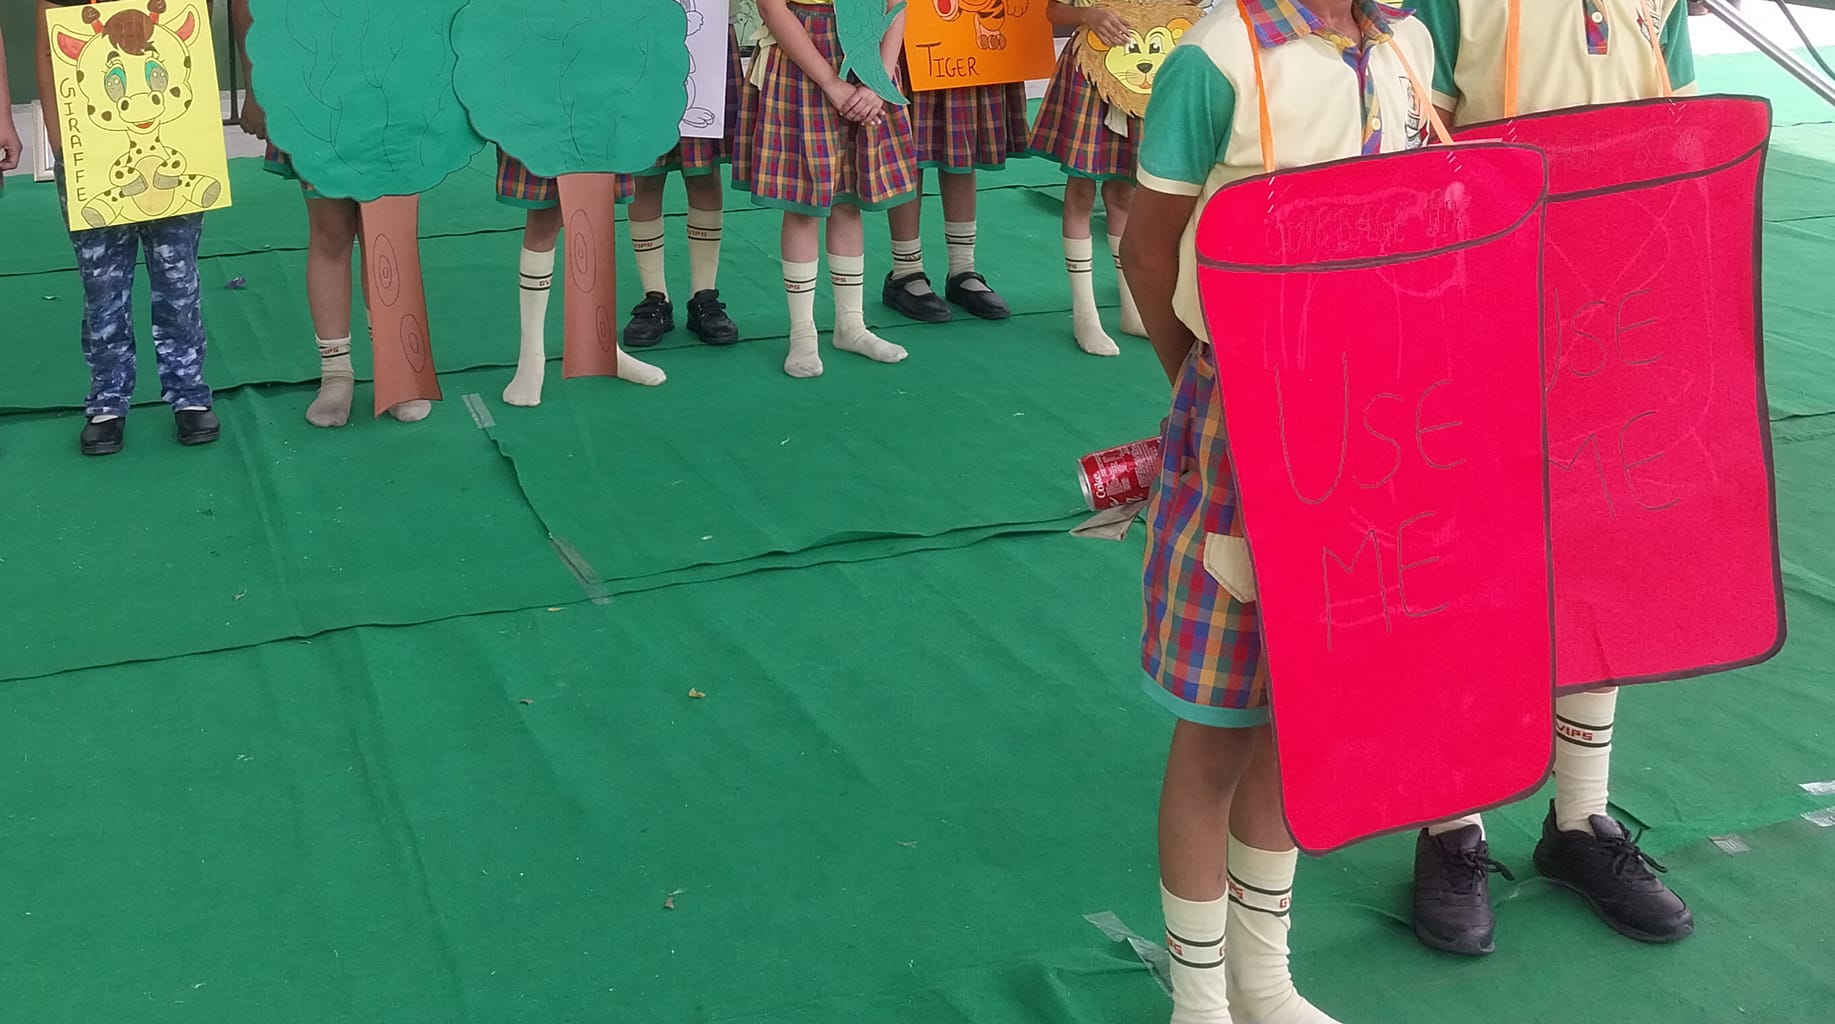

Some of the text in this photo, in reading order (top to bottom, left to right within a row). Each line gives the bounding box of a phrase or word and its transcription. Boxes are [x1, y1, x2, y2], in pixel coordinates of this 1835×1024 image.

[915, 40, 980, 78] TIGER
[59, 76, 88, 203] GIRAFFE
[1093, 470, 1106, 499] Coke
[1274, 352, 1467, 505] USE
[1322, 512, 1450, 652] ME
